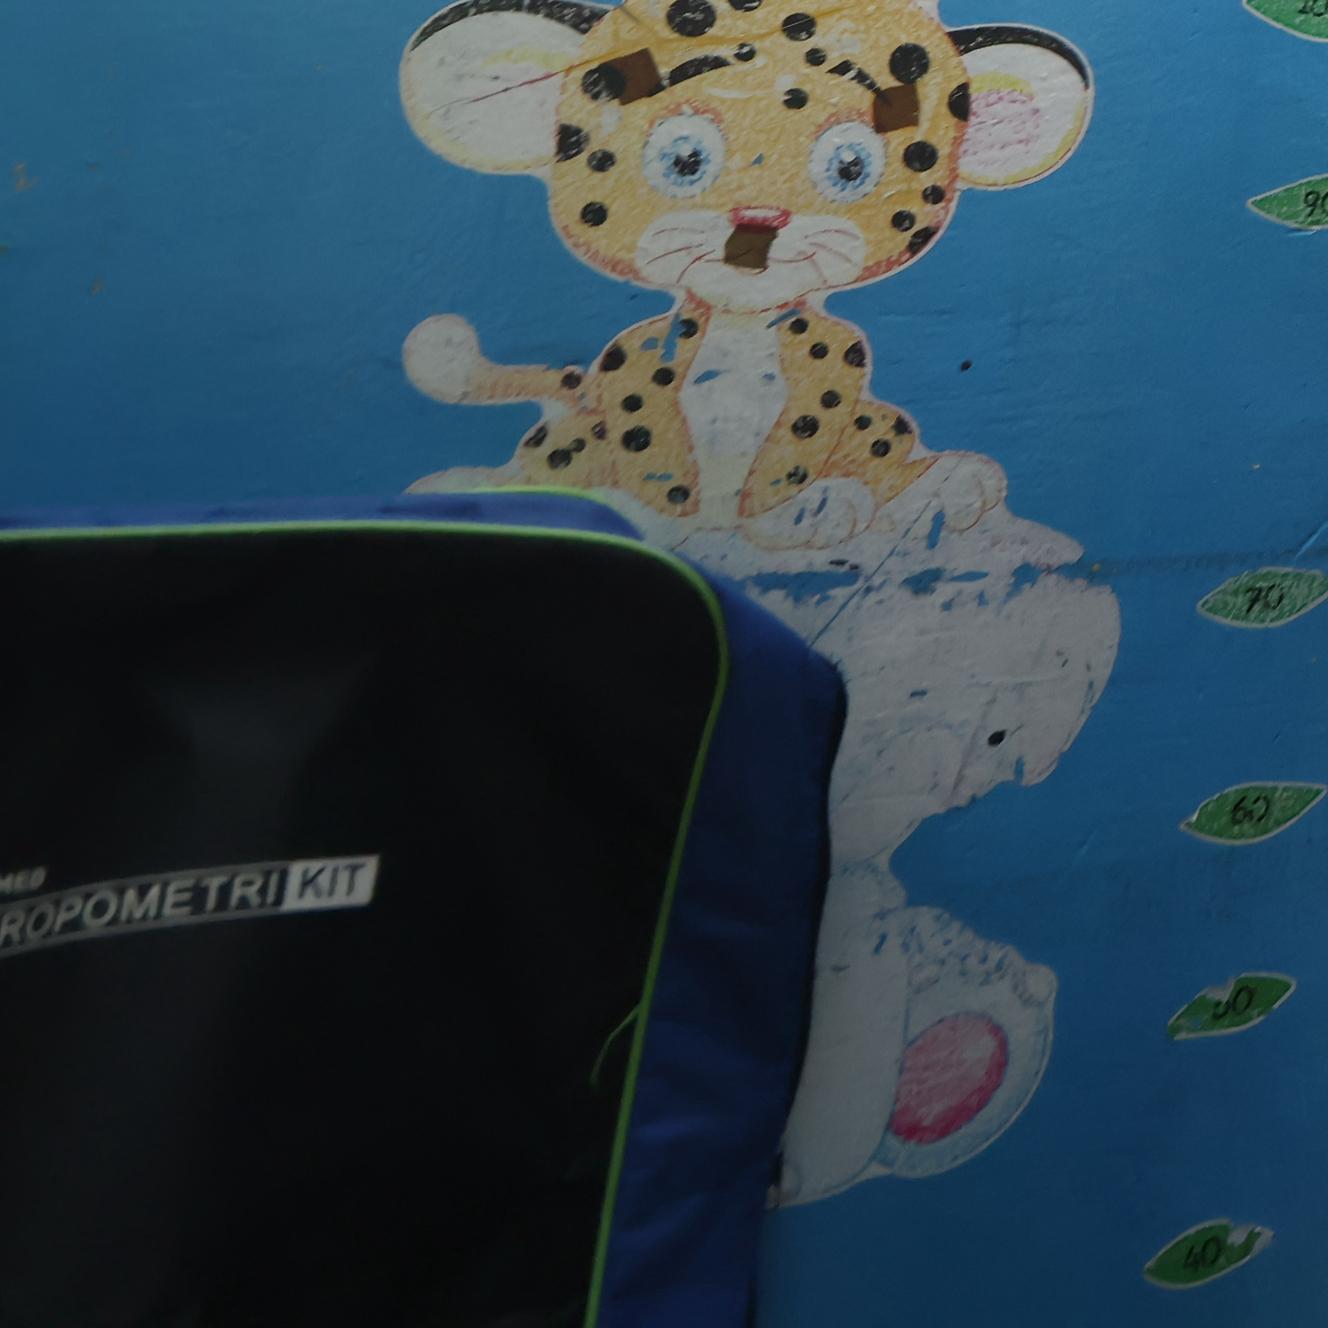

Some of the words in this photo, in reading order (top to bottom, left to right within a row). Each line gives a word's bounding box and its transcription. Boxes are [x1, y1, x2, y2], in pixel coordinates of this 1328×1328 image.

[1244, 583, 1286, 614] 70
[301, 863, 367, 900] KIT
[1183, 1236, 1222, 1272] 40
